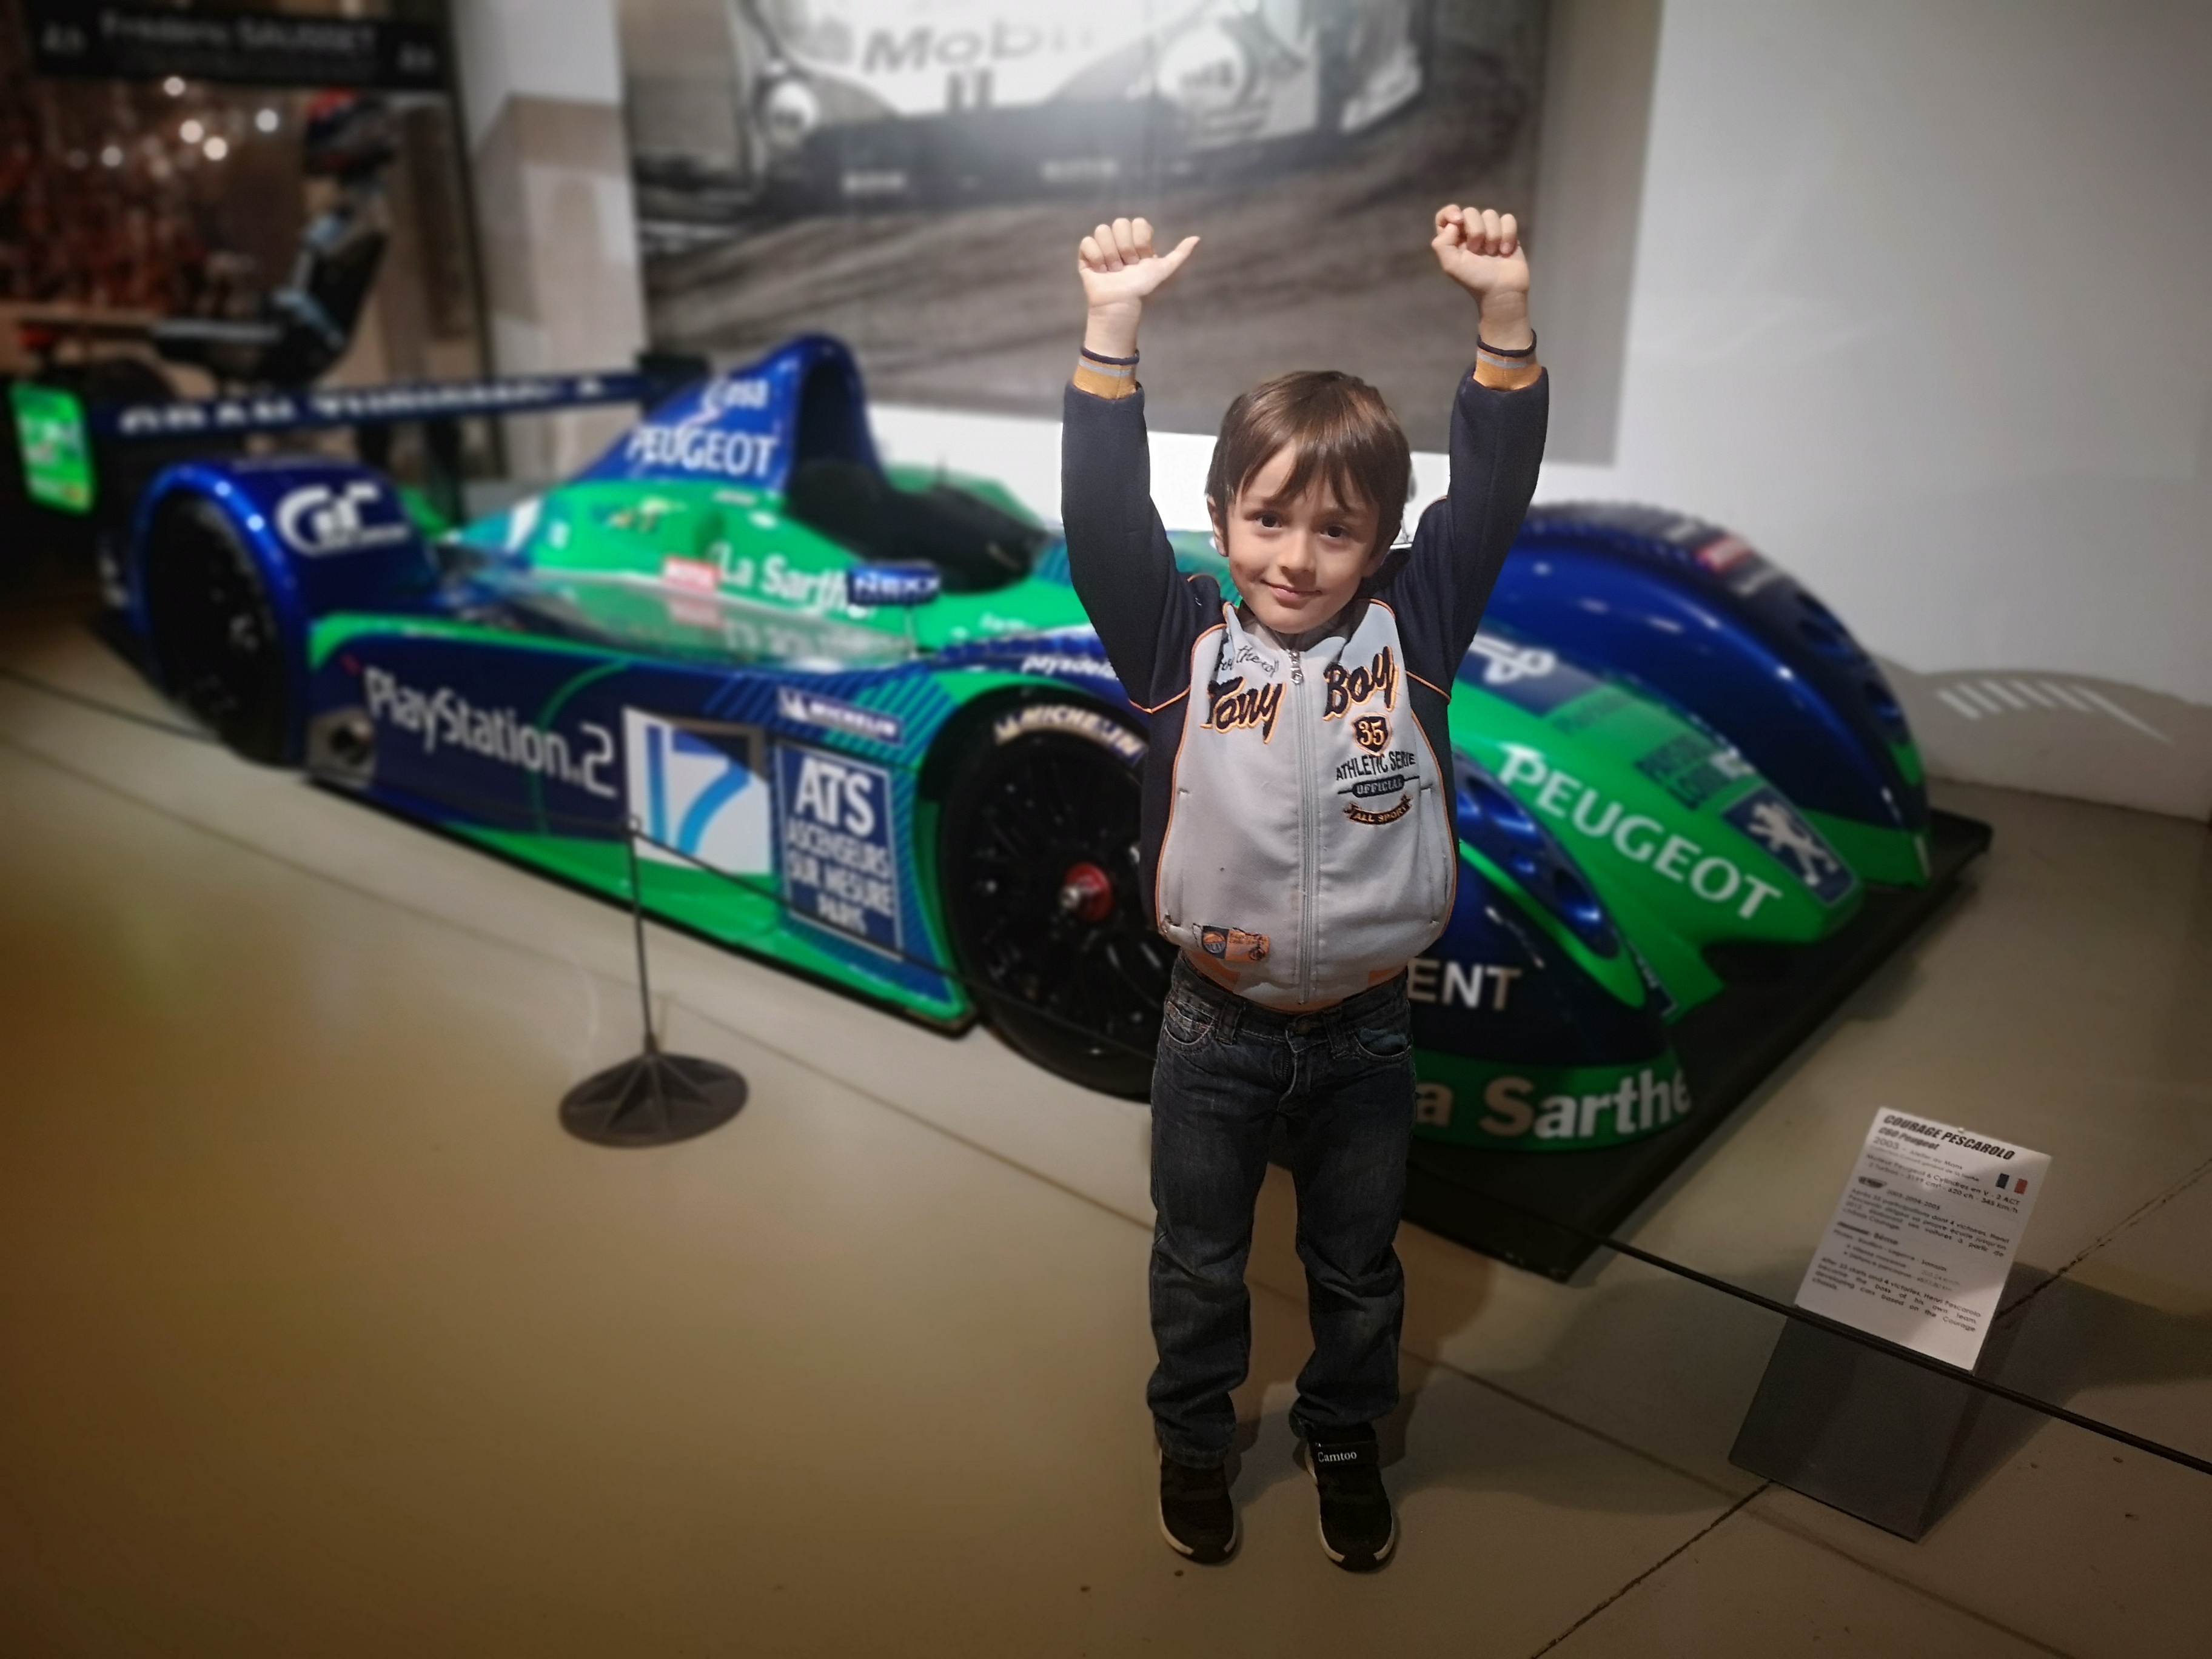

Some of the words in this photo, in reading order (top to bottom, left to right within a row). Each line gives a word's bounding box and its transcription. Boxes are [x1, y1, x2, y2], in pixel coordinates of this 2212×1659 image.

[625, 424, 782, 479] PEUGEOT
[365, 665, 570, 782] PlayStation
[1358, 720, 1384, 746] 35
[643, 723, 773, 856] 17
[1336, 756, 1389, 781] ATHLETIC
[794, 754, 877, 838] ATS
[1353, 812, 1374, 823] ALL
[1496, 741, 1784, 920] PEUGEOT
[1407, 956, 1523, 1011] ENT
[1480, 1068, 1692, 1140] Sarthe
[1872, 1136, 1899, 1150] 2003
[1883, 1114, 1943, 1138] COURAGE
[1940, 1131, 2016, 1160] PESCAROLO
[1898, 1132, 1940, 1150] Peugeot
[1893, 1161, 1926, 1176] Peugeot
[1932, 1174, 1968, 1190] Cylindres
[2003, 1196, 2020, 1205] ACT
[1931, 1215, 1948, 1223] dont
[1867, 1274, 1883, 1282] and
[1943, 1299, 1981, 1317] Pescarolo
[1880, 1293, 1905, 1306] based
[1942, 1315, 1976, 1332] Courage
[1931, 1304, 1948, 1313] own
[1318, 1451, 1357, 1463] Camtoo
